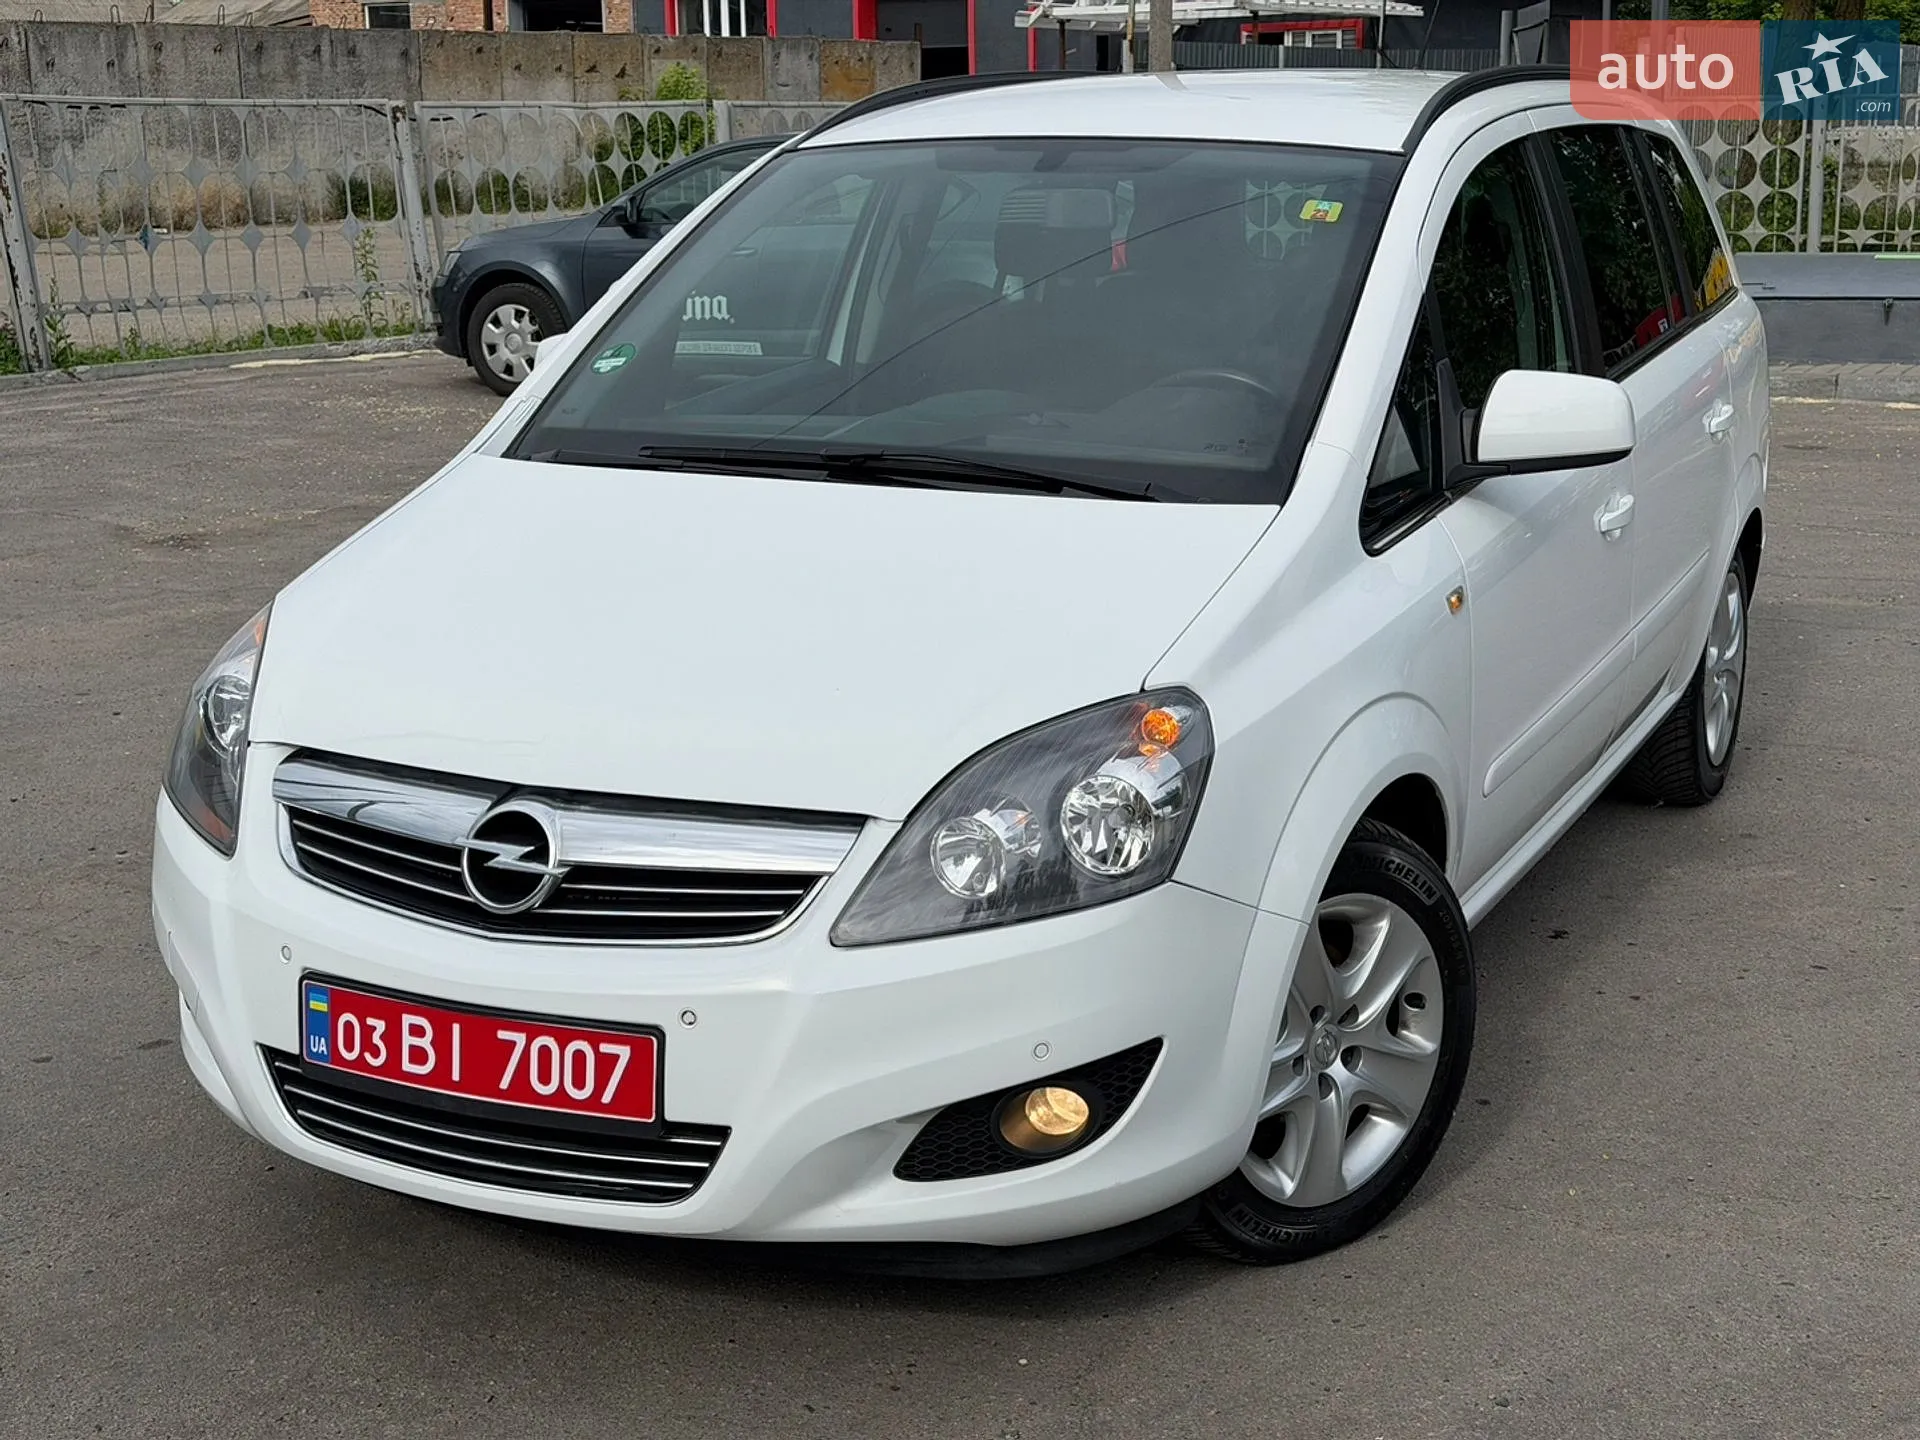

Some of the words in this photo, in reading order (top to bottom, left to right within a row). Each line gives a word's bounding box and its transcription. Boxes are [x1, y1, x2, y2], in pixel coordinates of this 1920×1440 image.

[309, 1034, 328, 1056] UA
[337, 1012, 388, 1067] 03
[496, 1029, 631, 1104] 7007
